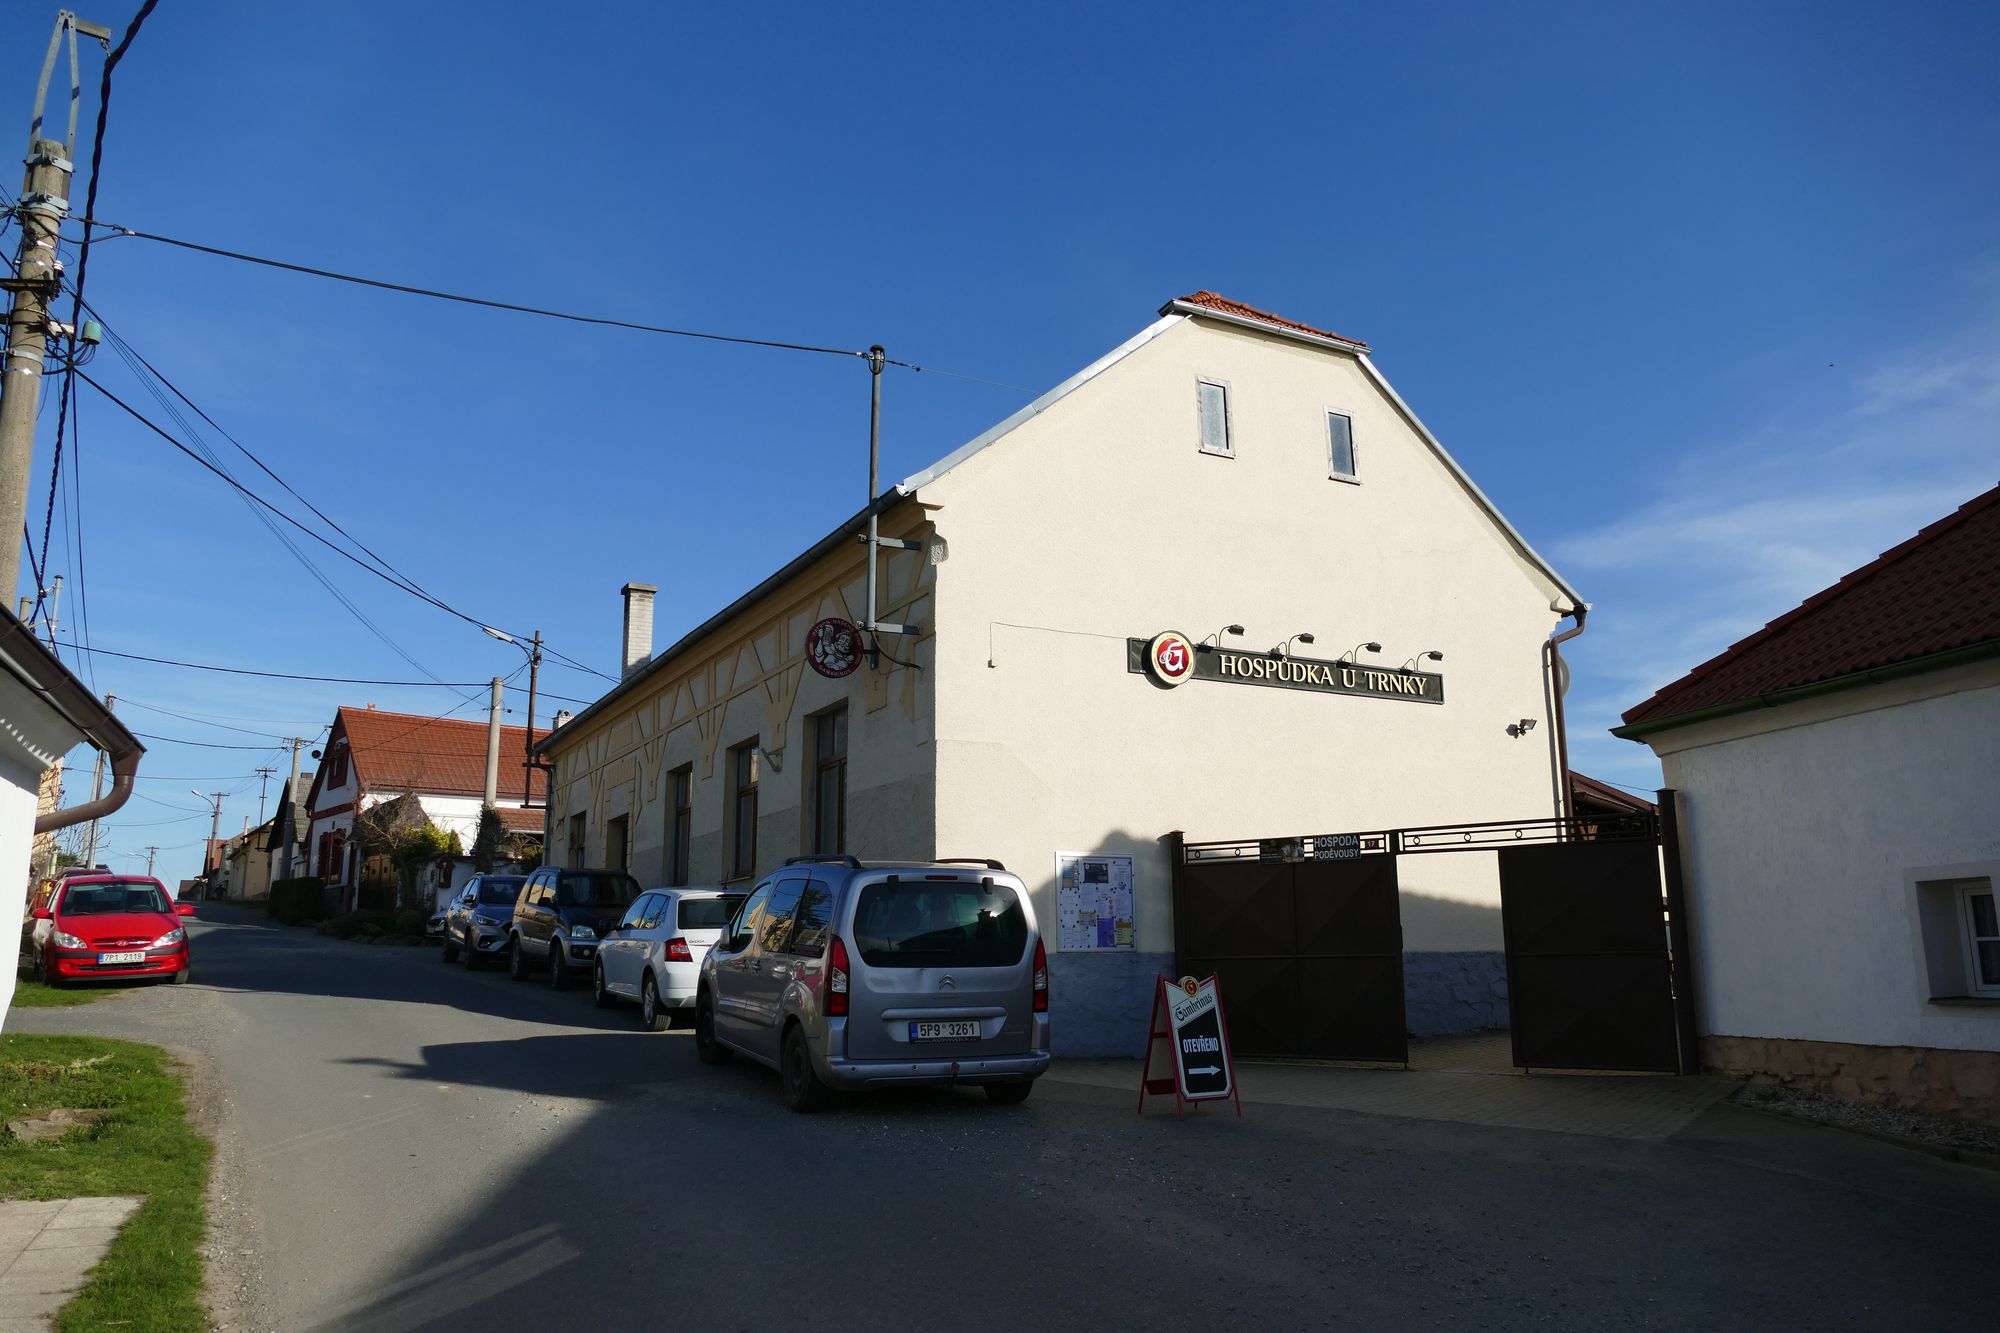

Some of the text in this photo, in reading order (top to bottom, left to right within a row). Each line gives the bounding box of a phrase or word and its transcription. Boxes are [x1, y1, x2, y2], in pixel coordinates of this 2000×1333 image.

[1219, 654, 1335, 686] HOSPŮDKA
[1341, 668, 1356, 688] U
[1364, 671, 1428, 696] TRNKY
[1314, 835, 1359, 847] HOSPODA
[1176, 993, 1213, 1021] Gambrinus
[920, 1023, 974, 1037] 5P9 3261
[1183, 1035, 1219, 1053] OTEVŘENO
